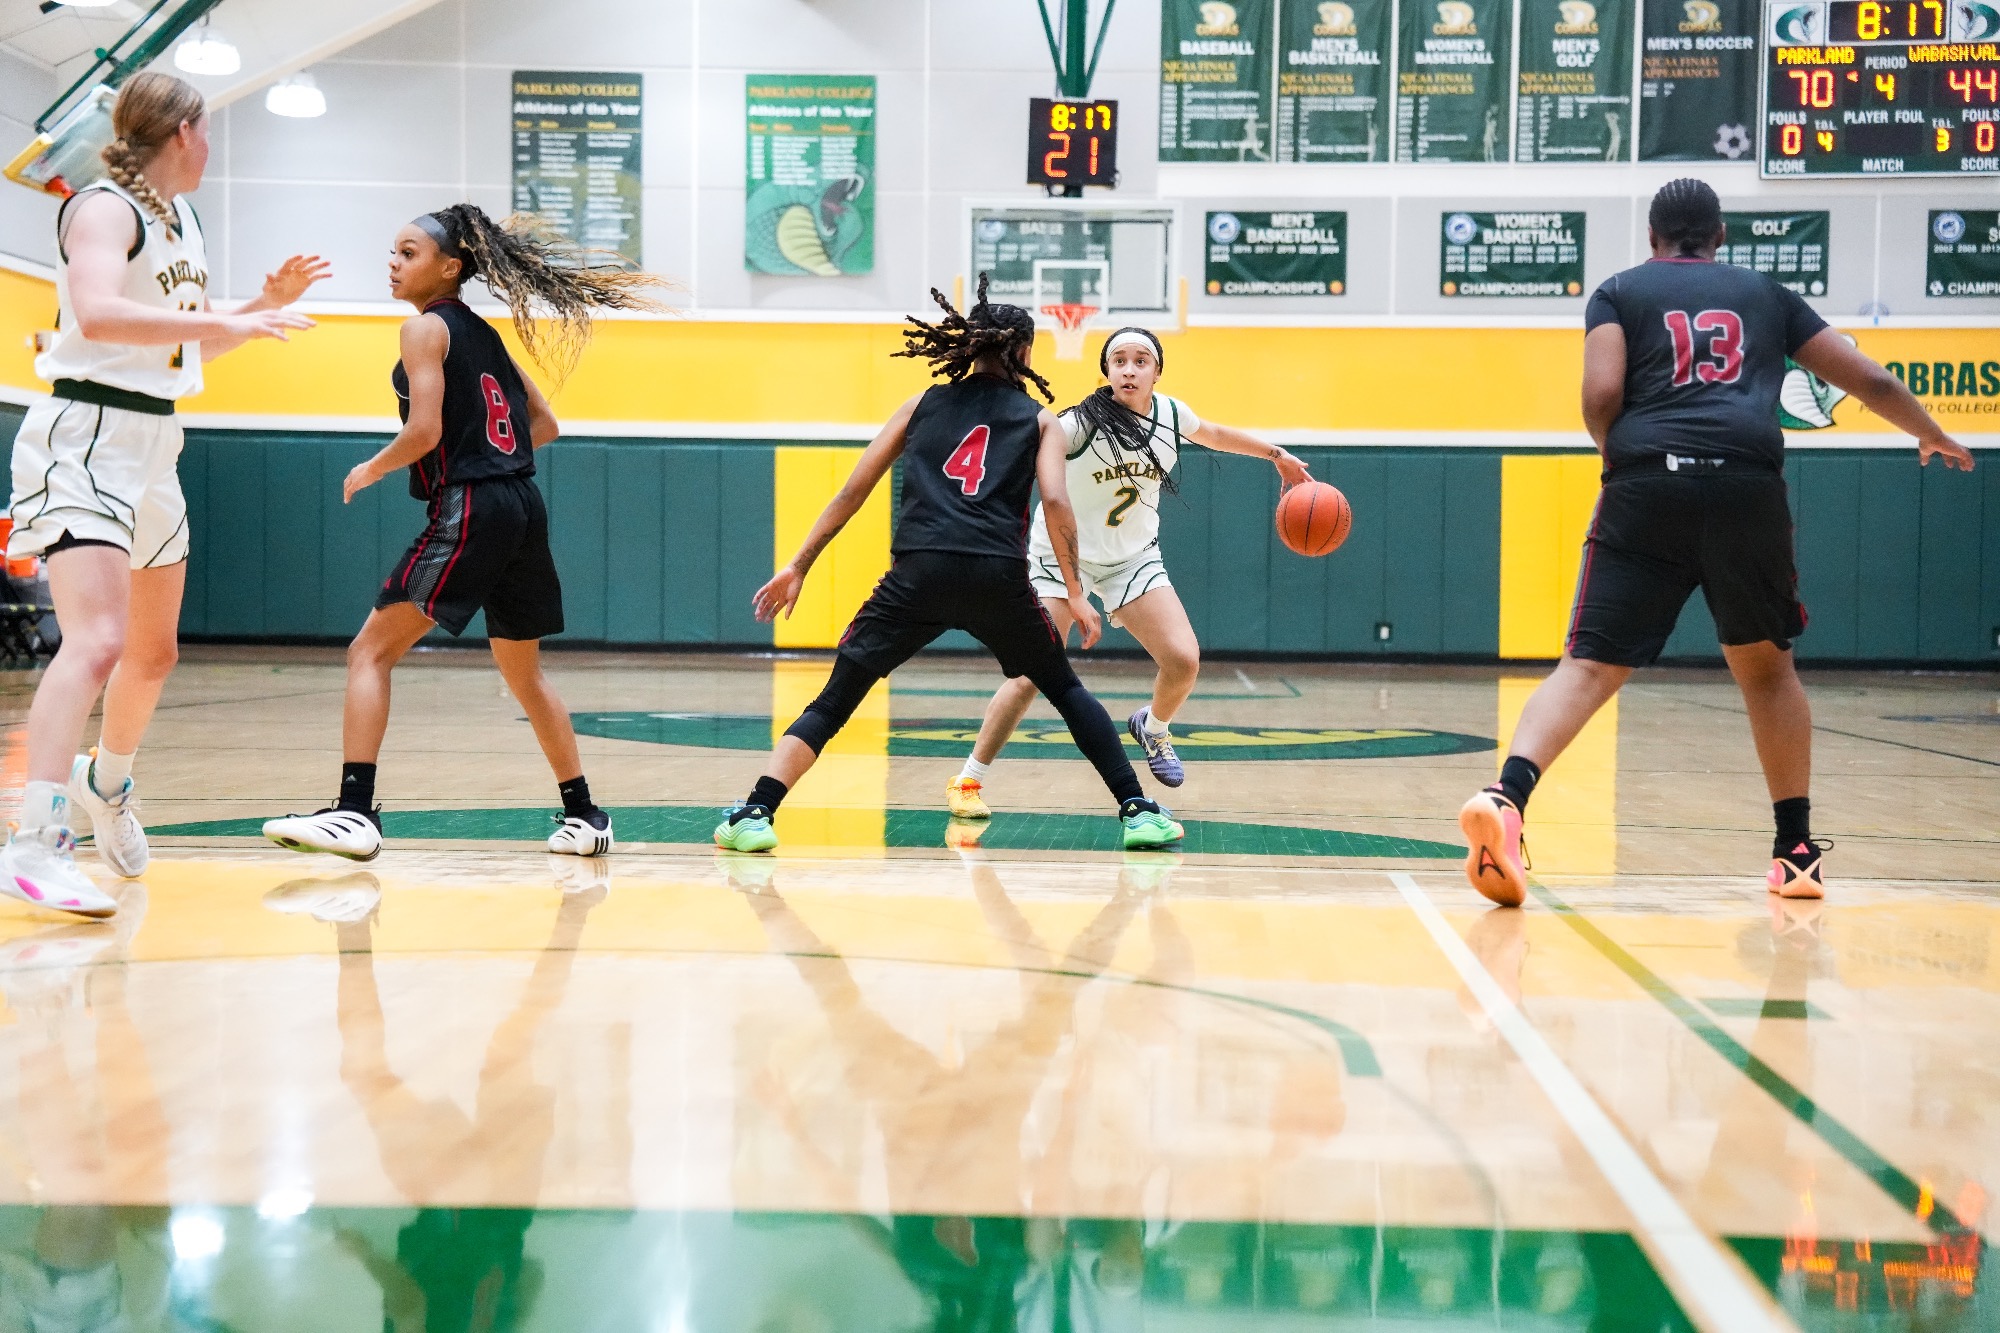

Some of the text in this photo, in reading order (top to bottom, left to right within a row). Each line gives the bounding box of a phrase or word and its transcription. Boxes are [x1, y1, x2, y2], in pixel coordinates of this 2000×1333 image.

[1857, 1, 1943, 40] 8:17
[1180, 41, 1255, 55] BASEBALL
[1311, 38, 1358, 51] MEN'S
[1424, 39, 1485, 51] WOMEN'S
[1552, 38, 1600, 53] MEN'S
[1647, 36, 1753, 50] MEN'S SOCCER
[1289, 50, 1380, 65] BASKETBALL
[1415, 51, 1494, 64] BASKETBALL
[1556, 53, 1596, 67] GOLF
[1777, 47, 1855, 64] PARKLAND
[1908, 46, 1969, 62] WABASH
[1865, 56, 1907, 70] PERIOD
[515, 83, 639, 96] PARKLAND COLLEGE
[749, 87, 872, 98] PARKLAND COLLEGE
[1789, 70, 1834, 108] 70
[1875, 73, 1895, 101] 4
[1949, 69, 1998, 103] 44
[514, 102, 640, 115] Athletes of the Year
[749, 105, 873, 117] Athletes of the Year
[1962, 109, 2000, 123] FOULS
[1051, 104, 1111, 132] 8:17
[1769, 111, 1807, 125] FOULS
[1844, 110, 1925, 125] PLAYER FOUL
[1782, 125, 1802, 155] 0
[1817, 131, 1833, 152] 4
[1936, 128, 1950, 152] 3
[1976, 122, 1995, 152] 0
[1044, 132, 1099, 178] 21
[1768, 159, 1806, 174] SCORE
[1863, 158, 1904, 172] MATCH
[1961, 157, 2000, 171] SCORE
[1271, 213, 1315, 228] MEN'S
[1494, 213, 1562, 229] WOMEN'S
[1752, 220, 1792, 236] GOLF
[1246, 228, 1338, 244] BASKETBALL
[1482, 229, 1576, 244] BASKETBALL
[1223, 281, 1326, 294] CHAMPIONSHIPS
[1460, 282, 1563, 295] CHAMPIONSHIPS
[1949, 282, 2000, 295] CHAMPI
[1664, 309, 1744, 387] 13
[1884, 361, 2000, 397] OBRAS
[481, 372, 516, 455] 8
[1938, 402, 2000, 414] COLLEGE
[942, 424, 990, 496] 4
[1092, 462, 1162, 484] PARKLAN
[1105, 485, 1139, 529] 2
